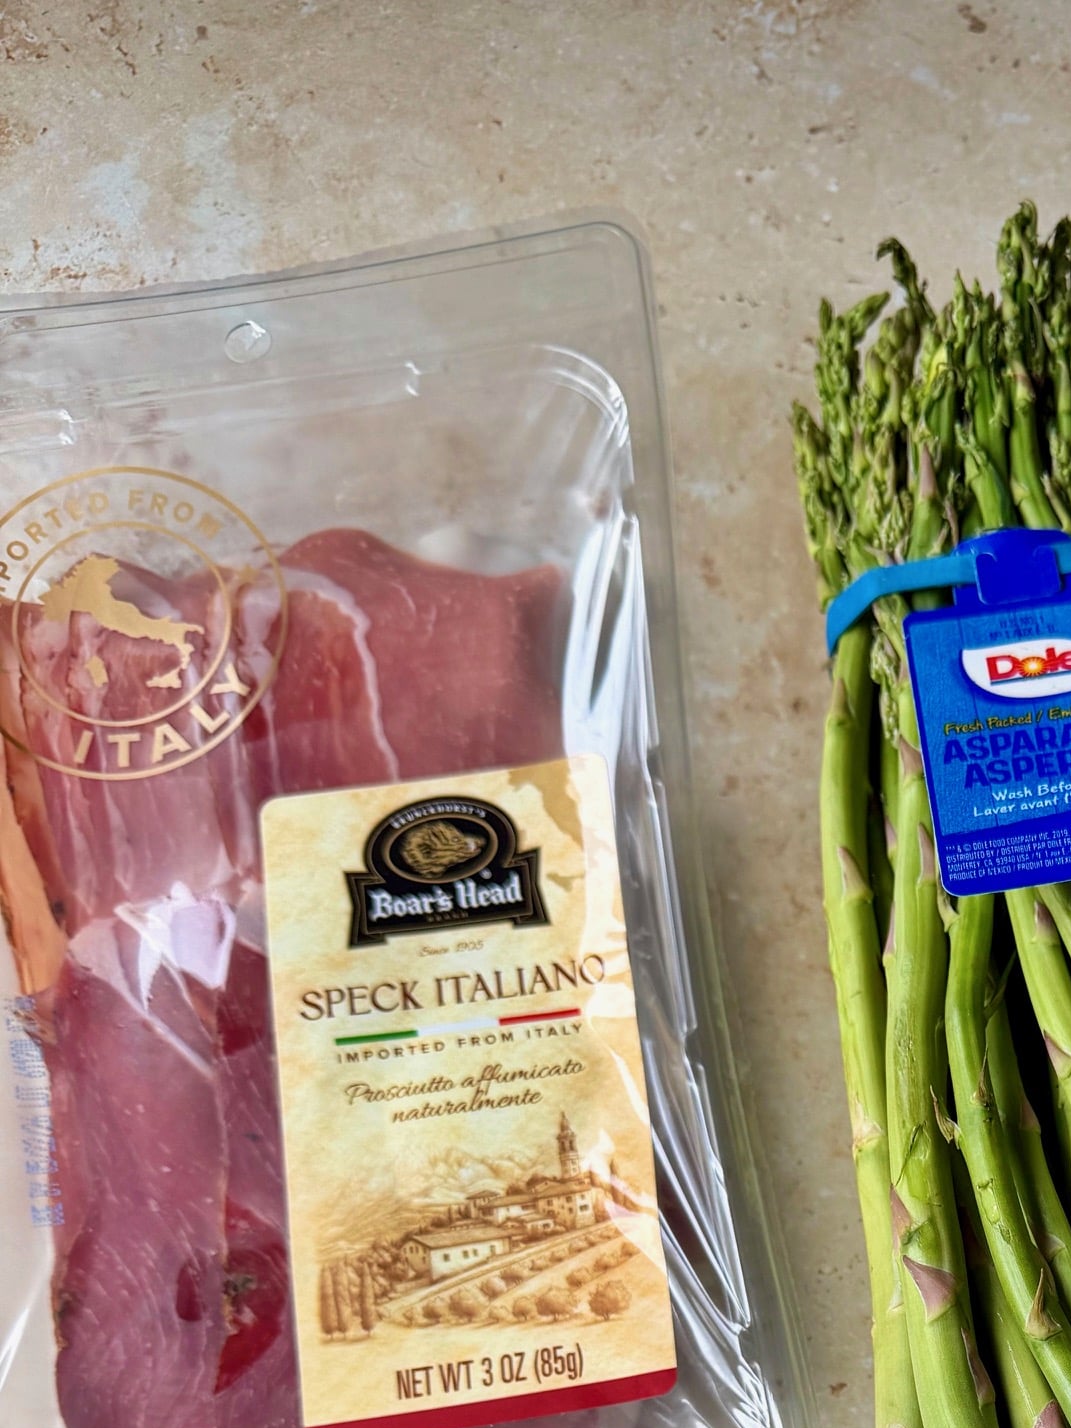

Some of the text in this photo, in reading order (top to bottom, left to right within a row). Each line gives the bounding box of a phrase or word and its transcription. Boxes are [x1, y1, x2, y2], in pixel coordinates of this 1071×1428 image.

[0, 489, 223, 593] PORTED FROM
[74, 663, 251, 768] ITALY
[944, 721, 983, 736] Fresh
[987, 714, 1032, 730] Packed
[973, 803, 1016, 817] Laver
[1020, 797, 1059, 811] avant
[991, 785, 1033, 802] Wash
[946, 852, 986, 863] DISTRIBUTED
[986, 850, 995, 859] BY
[1032, 841, 1046, 851] PAR
[1047, 838, 1062, 849] DOLE
[989, 838, 1006, 848] FOOD
[1006, 834, 1038, 846] COMPANY
[1016, 853, 1030, 863] USA
[948, 870, 977, 882] PRODUCE
[987, 865, 1012, 876] MEXICO
[1017, 860, 1044, 872] PRODUIT
[1044, 858, 1054, 868] DU
[366, 870, 524, 922] Boar's Head
[299, 953, 606, 1021] SPECK ITALIANO
[336, 1022, 583, 1065] IMPORTED FROM ITALY
[343, 1059, 586, 1106] Prosciutto affumicato
[391, 1087, 544, 1124] naturalmente
[396, 1343, 585, 1401] NET WT 3 OZ (85g)
